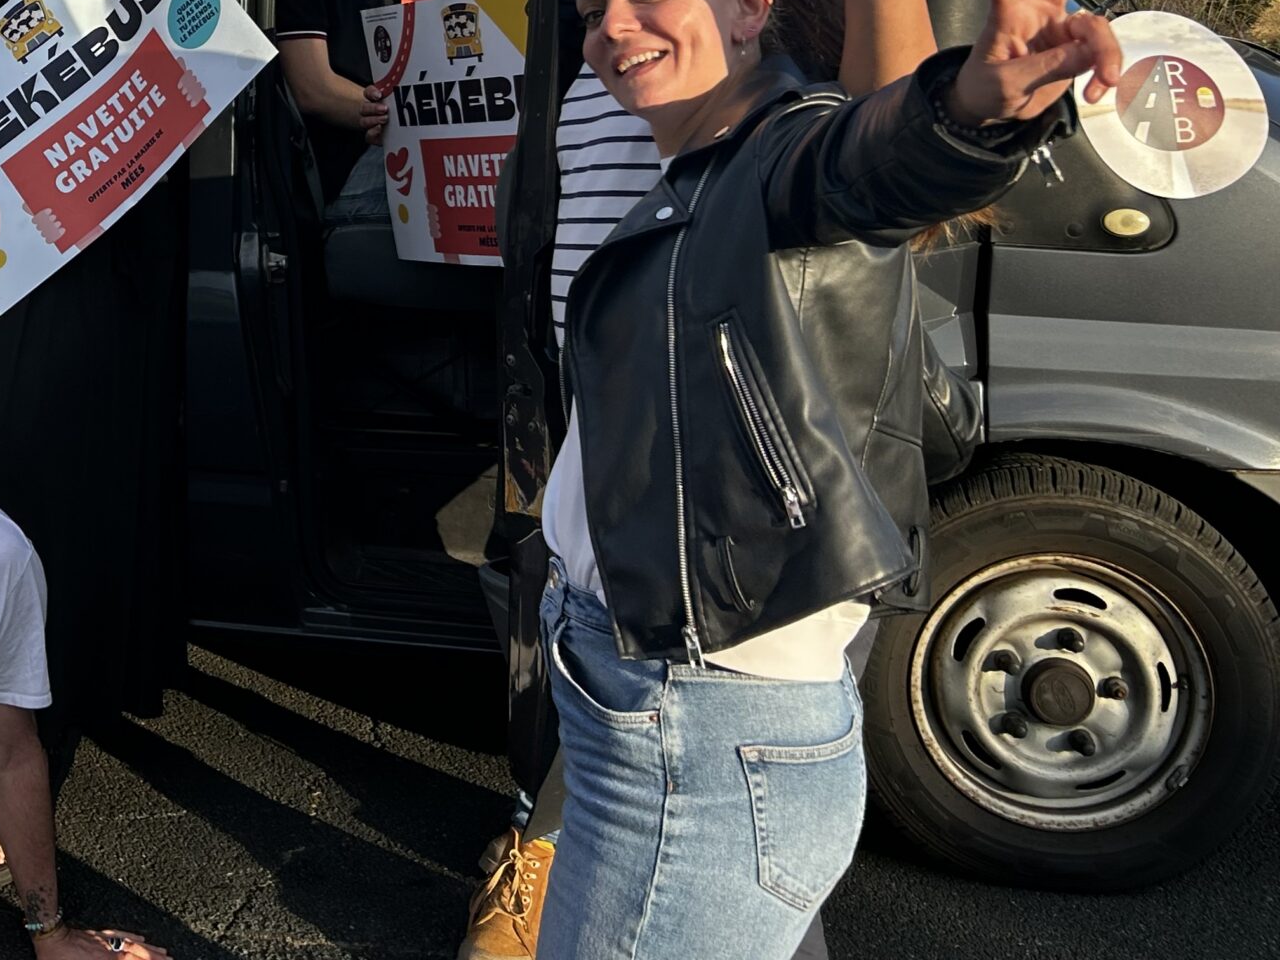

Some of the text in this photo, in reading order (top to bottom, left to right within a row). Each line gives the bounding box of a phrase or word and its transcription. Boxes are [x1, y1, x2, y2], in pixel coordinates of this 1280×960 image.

[176, 15, 186, 26] TU
[186, 7, 196, 18] AS
[178, 1, 213, 34] TU PRENDS
[179, 33, 188, 43] LE
[43, 69, 148, 169] NAVETTE
[55, 84, 167, 194] GRATUITE
[113, 167, 128, 183] PAR
[127, 159, 136, 169] LA
[156, 128, 165, 139] DE
[121, 164, 146, 190] MÉES
